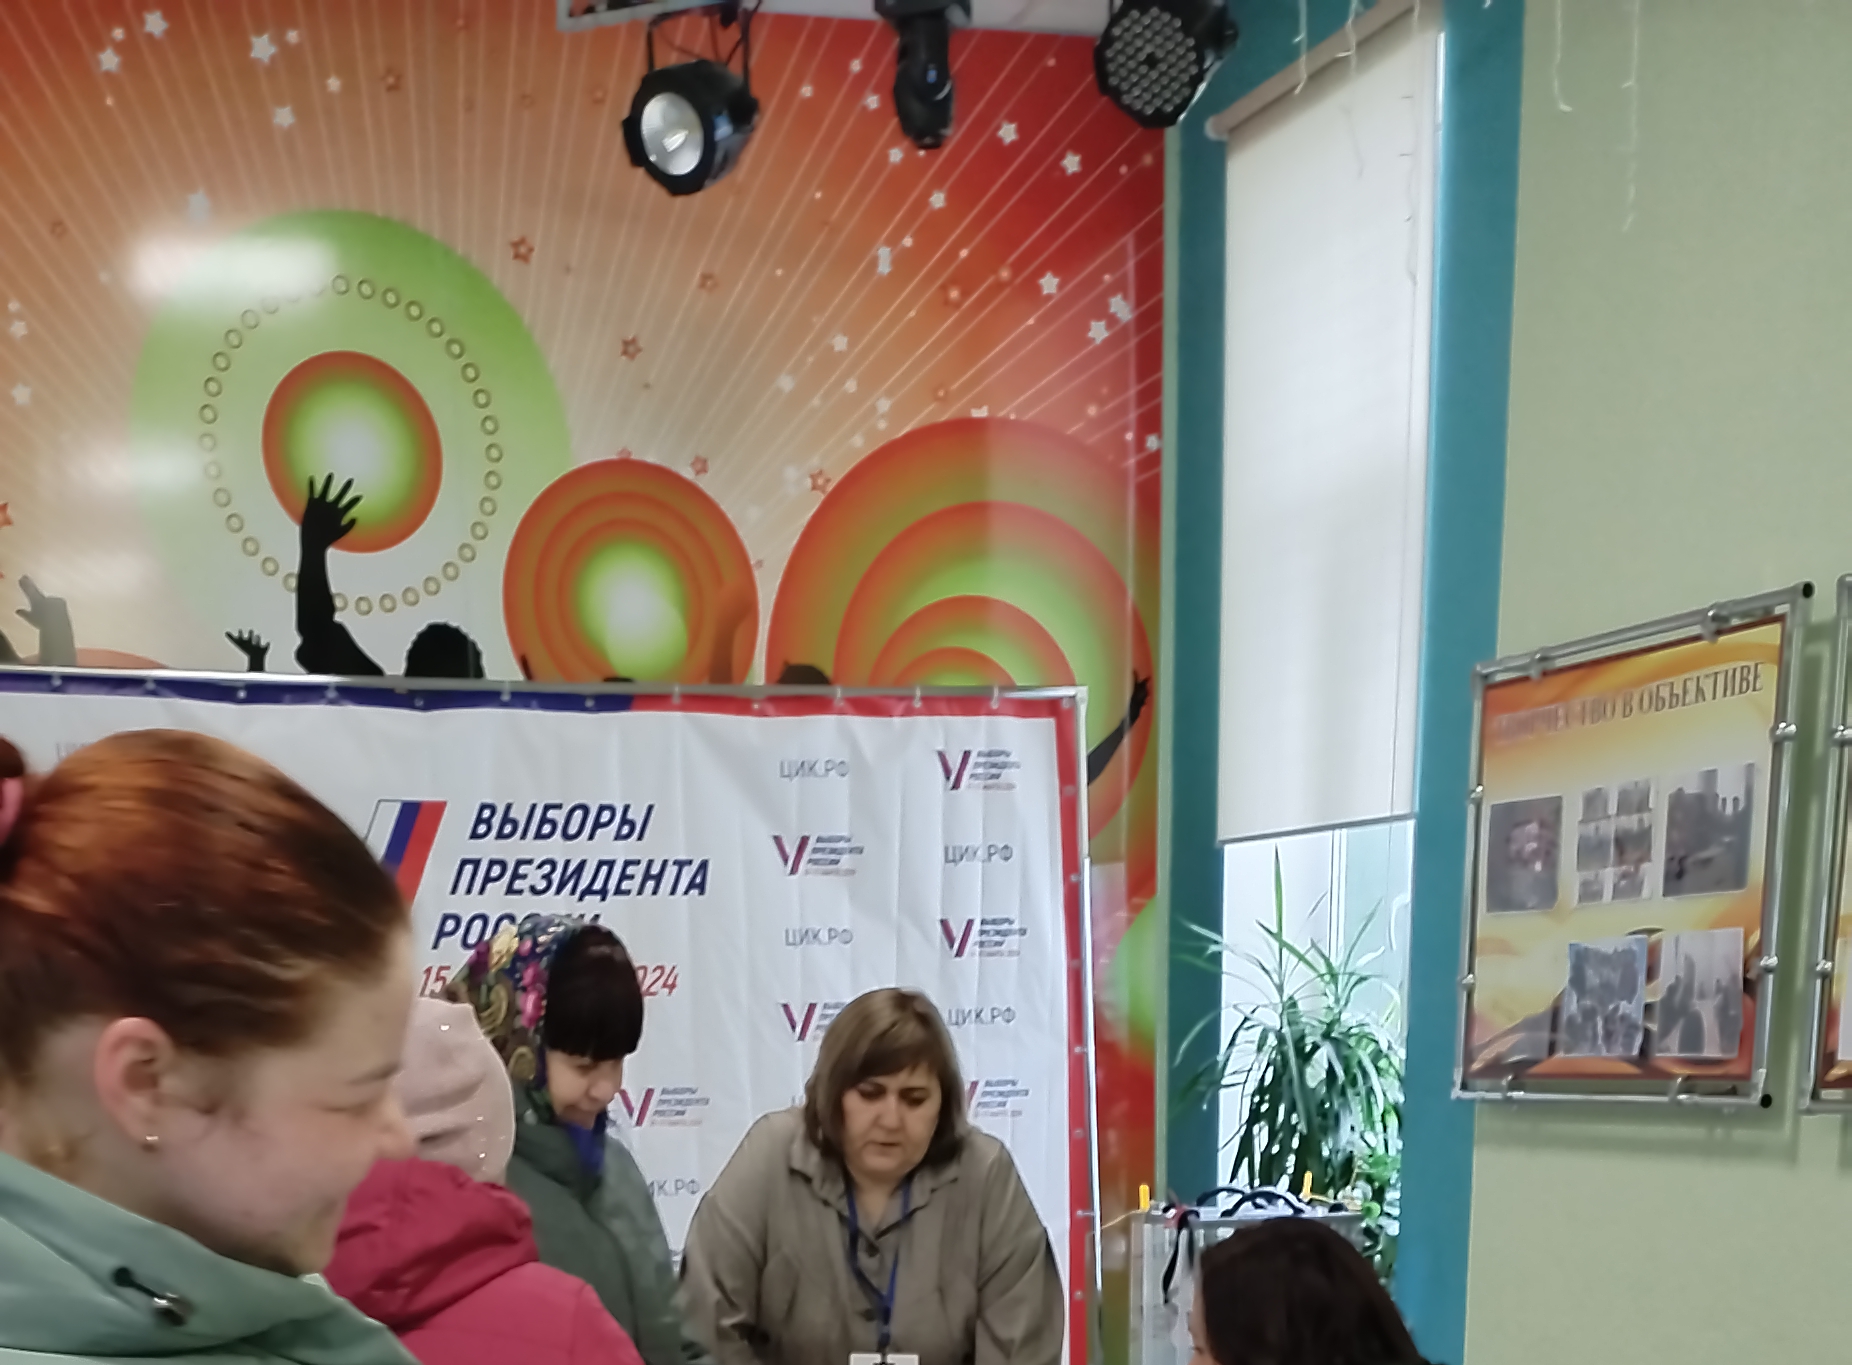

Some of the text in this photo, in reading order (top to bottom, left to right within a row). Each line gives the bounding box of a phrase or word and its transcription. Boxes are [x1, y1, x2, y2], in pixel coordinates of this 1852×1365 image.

[1638, 662, 1765, 716] ОБЪЕКТИВЕ
[468, 801, 656, 842] ВЫБОРЫ
[449, 857, 711, 903] ПРЕЗИДЕНТА
[948, 1007, 1017, 1029] ЦИК.РФ
